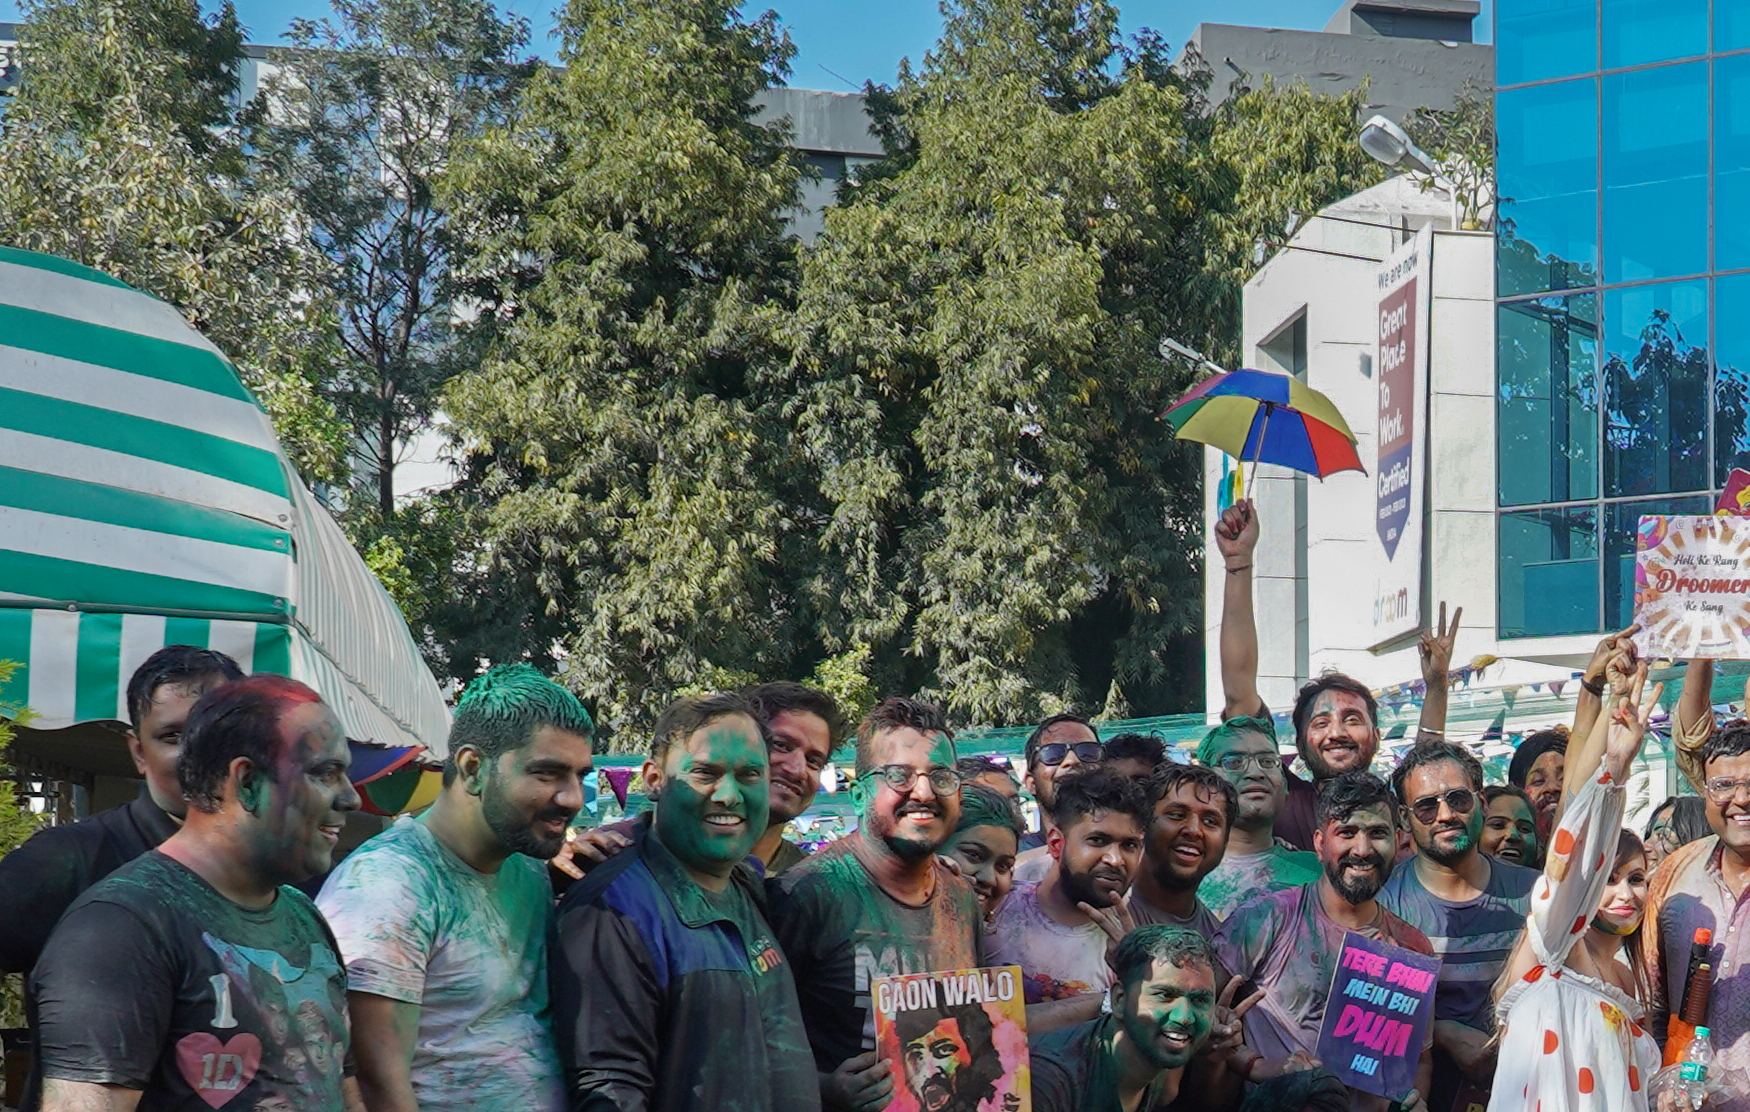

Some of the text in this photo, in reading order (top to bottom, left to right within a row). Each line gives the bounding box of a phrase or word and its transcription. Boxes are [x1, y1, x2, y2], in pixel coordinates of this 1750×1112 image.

[1380, 302, 1407, 341] Great
[1380, 340, 1406, 376] Place
[1380, 381, 1390, 411] To
[1378, 457, 1410, 498] Certified
[1674, 554, 1694, 566] Holi
[1713, 555, 1739, 570] Rang
[1700, 601, 1724, 615] Sang
[1342, 946, 1436, 993] TERE BHAI
[877, 970, 1014, 1015] GAON WALO
[1342, 978, 1420, 1016] MEIN BHI
[1332, 1004, 1414, 1057] DUM
[199, 1053, 244, 1090] 1D
[1350, 1054, 1379, 1076] HAI
